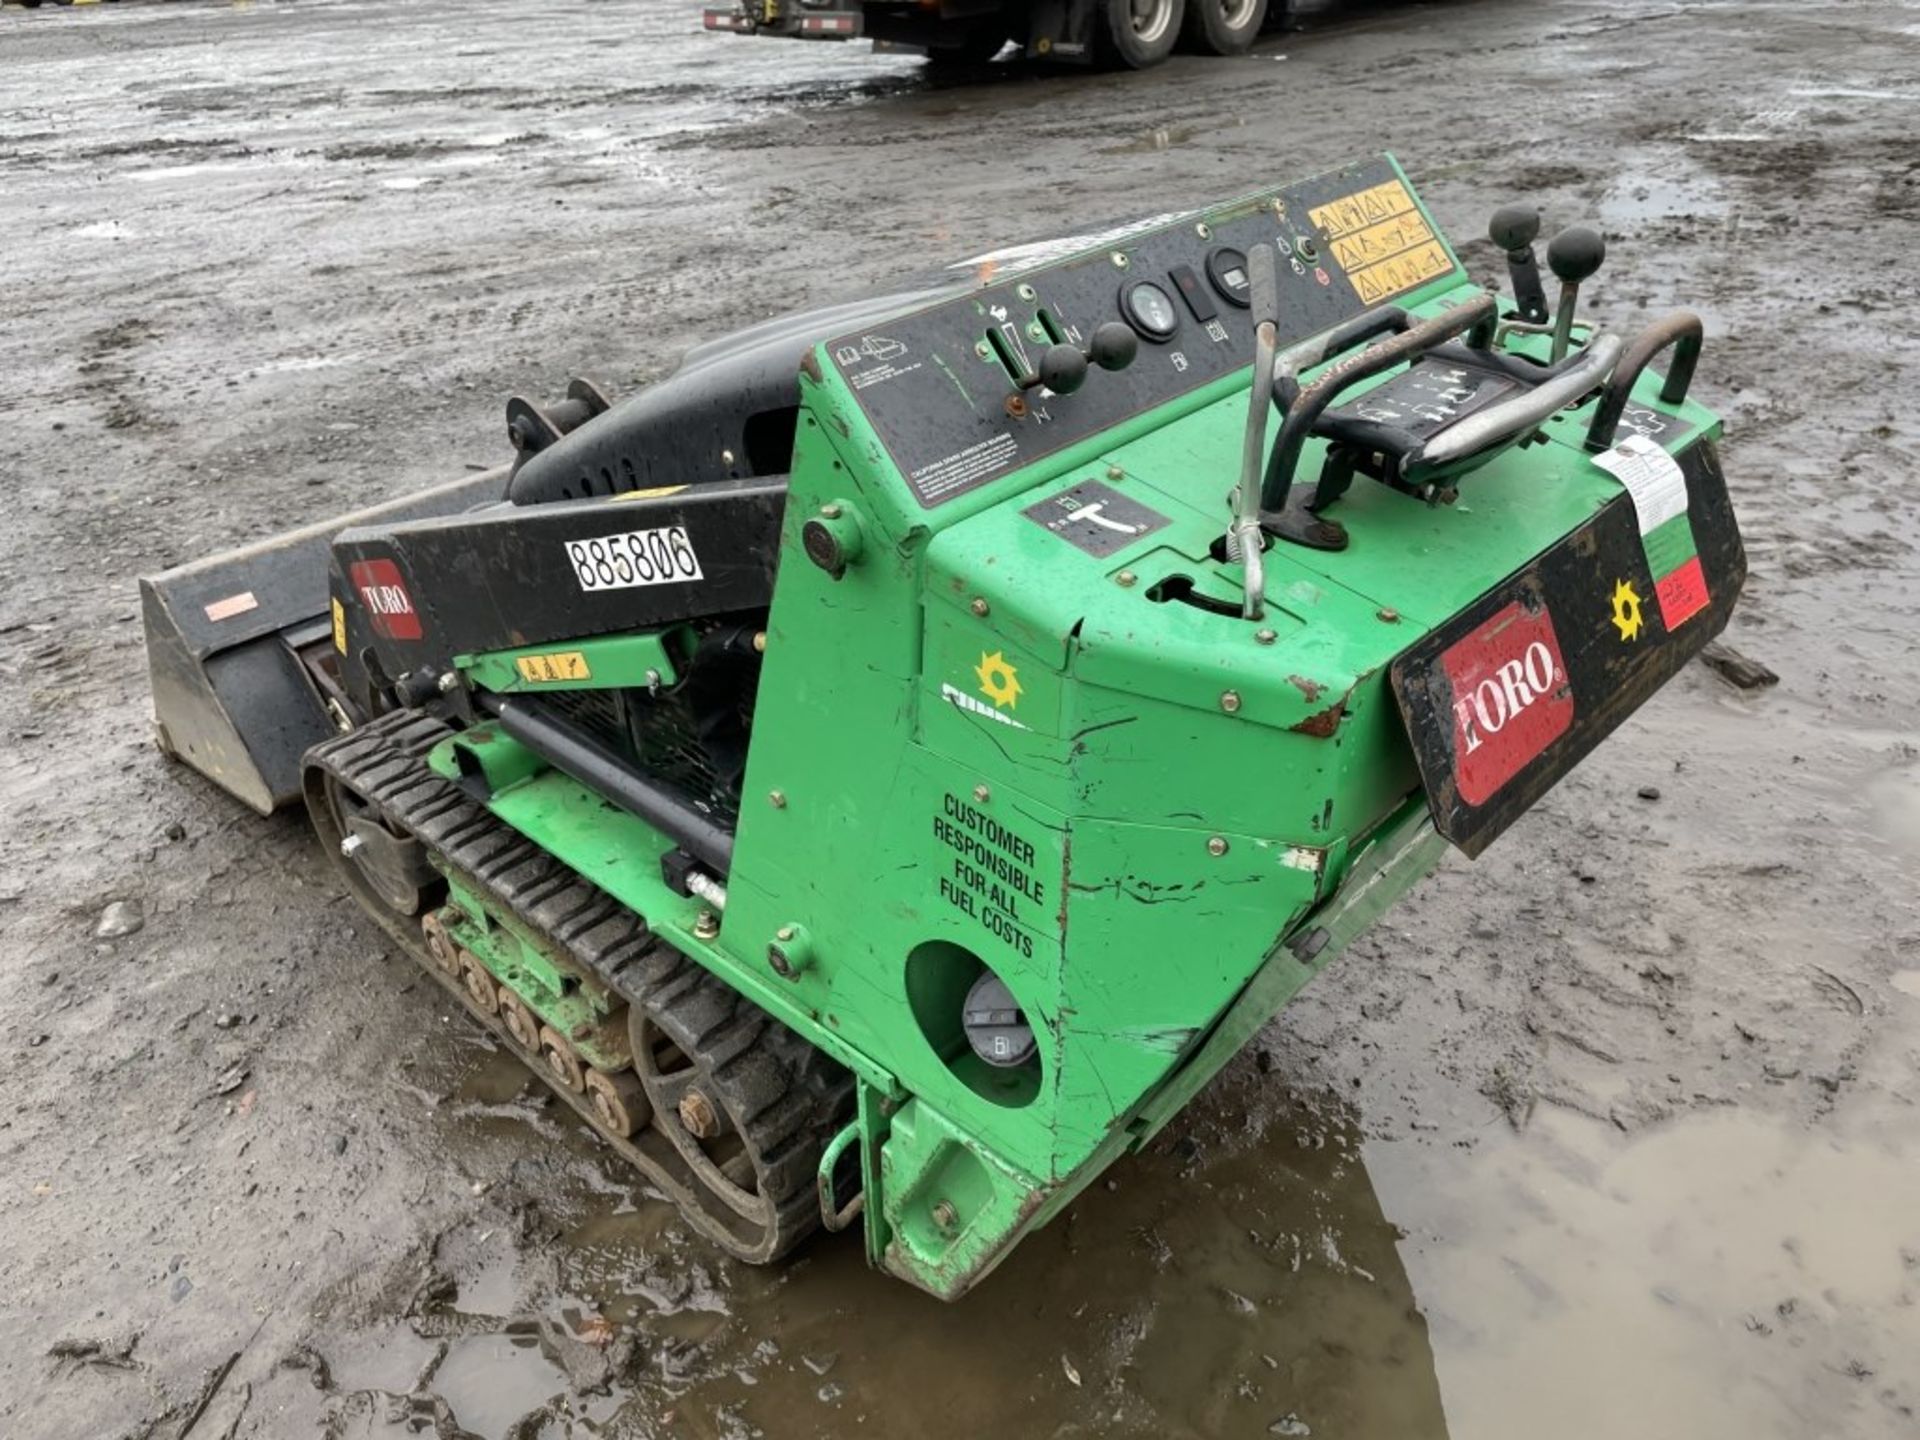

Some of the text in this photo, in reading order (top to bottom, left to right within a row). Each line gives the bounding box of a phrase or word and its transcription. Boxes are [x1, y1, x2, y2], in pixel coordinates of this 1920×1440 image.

[572, 528, 696, 587] 885806
[361, 585, 407, 613] TORO
[1453, 642, 1554, 755] TORO
[934, 815, 1044, 907] RESPONSIBLE
[944, 792, 1036, 869] CUSTOMER
[940, 876, 1033, 959] FUEL COSTS
[955, 858, 1019, 920] FOR ALL
